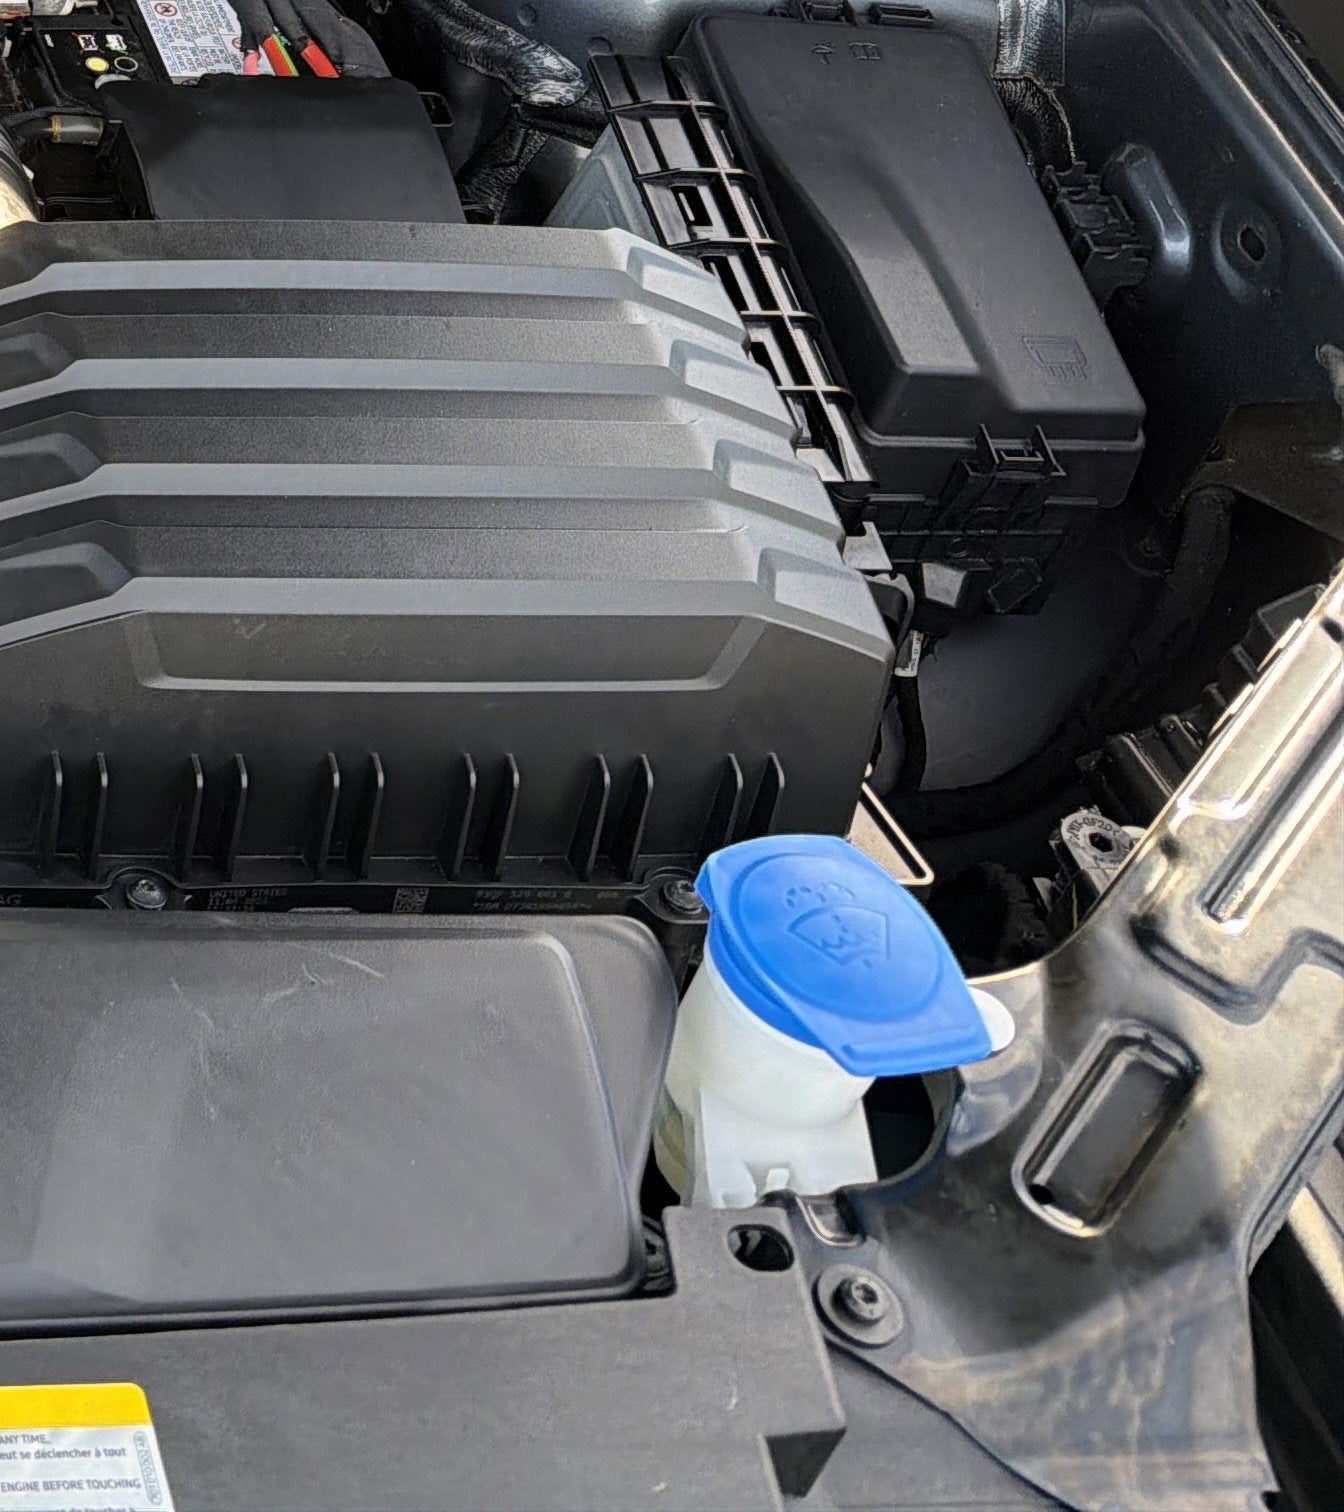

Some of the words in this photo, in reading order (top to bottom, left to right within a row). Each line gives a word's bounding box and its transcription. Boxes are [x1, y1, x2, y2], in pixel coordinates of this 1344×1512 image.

[20, 1451, 31, 1459] se
[103, 1448, 126, 1457] tout
[1, 1481, 40, 1492] ENGINE
[43, 1480, 83, 1491] BEFORE
[86, 1479, 141, 1489] TOUCHING
